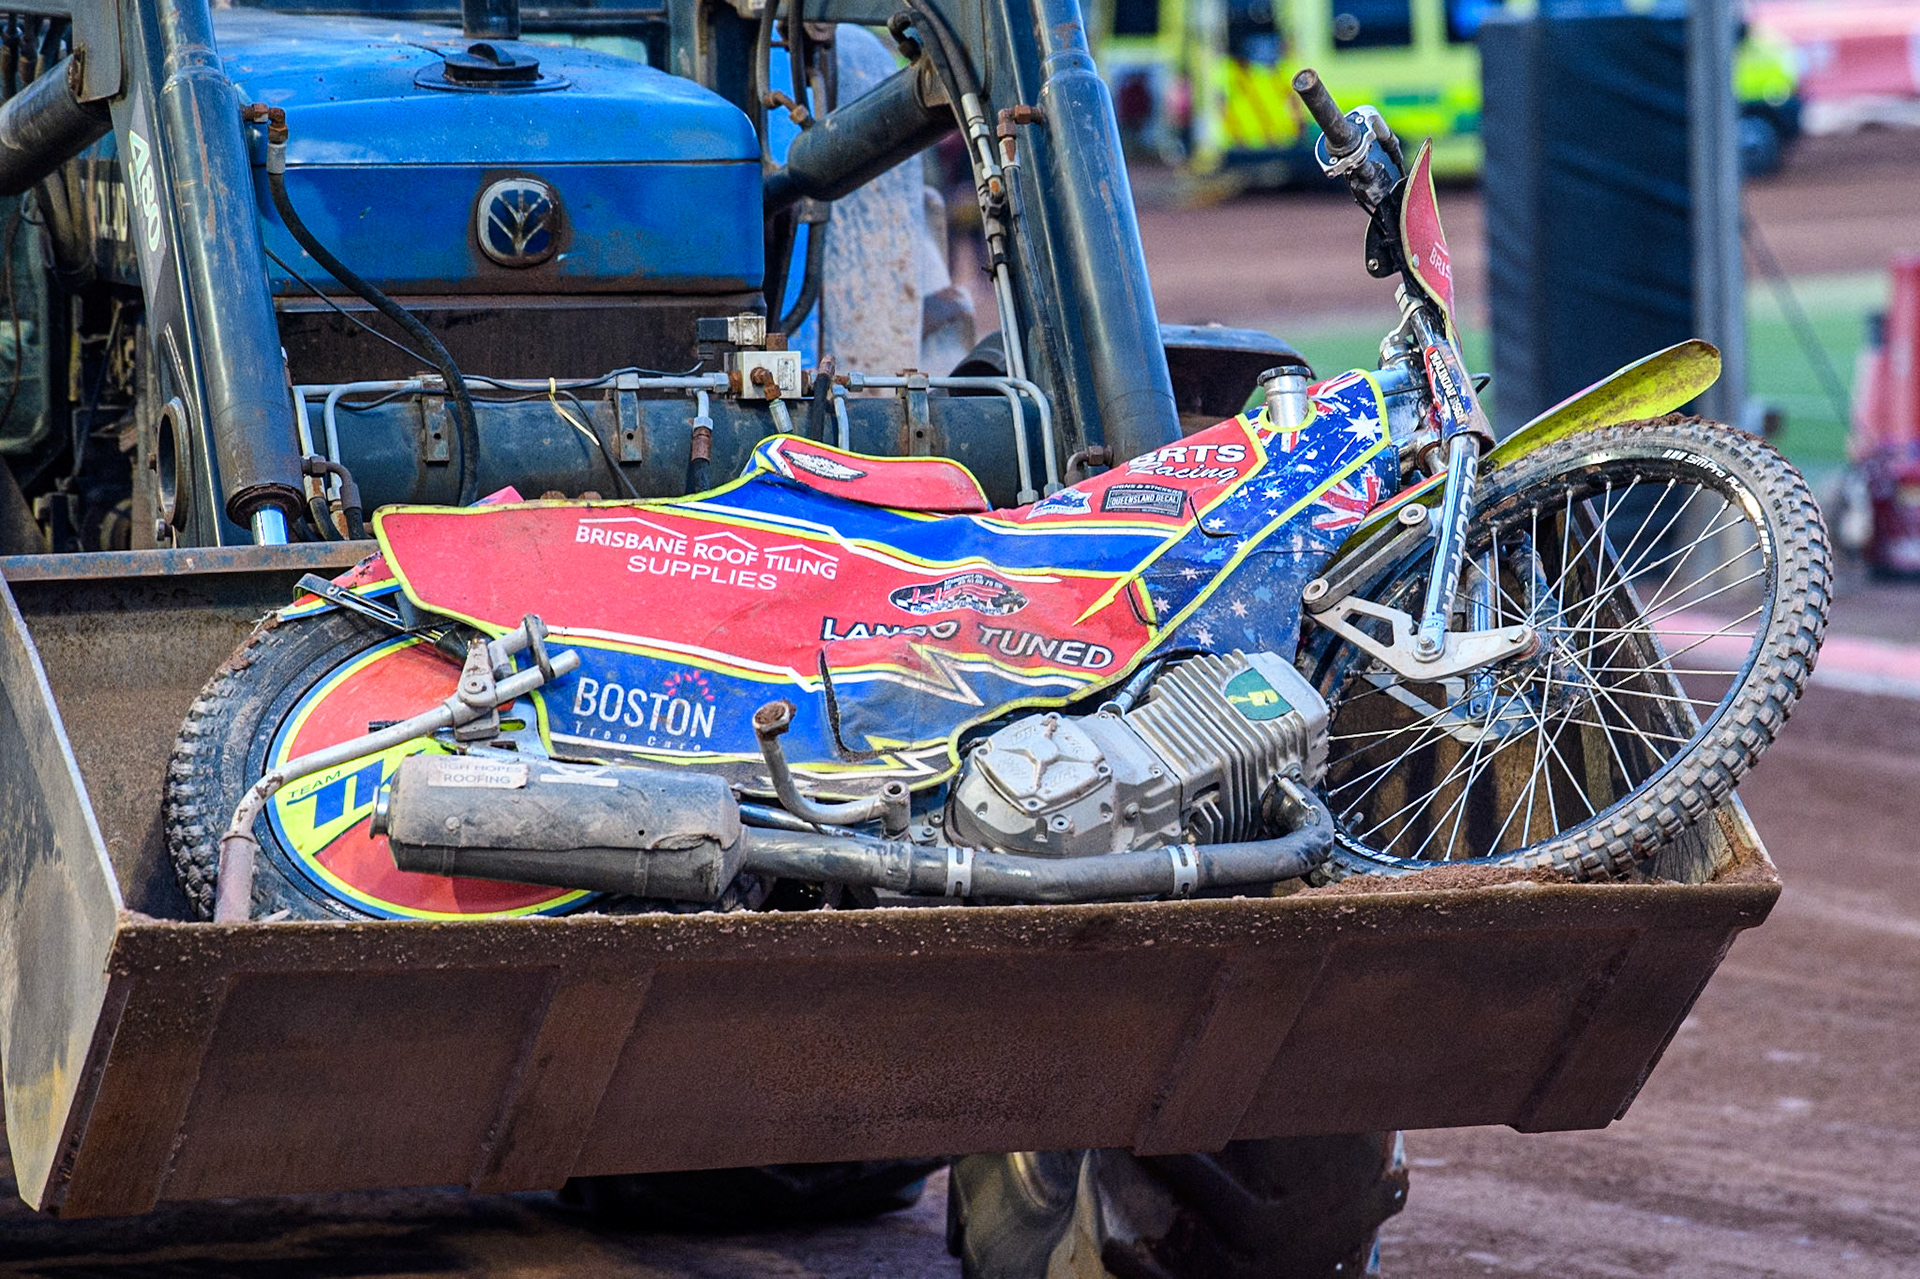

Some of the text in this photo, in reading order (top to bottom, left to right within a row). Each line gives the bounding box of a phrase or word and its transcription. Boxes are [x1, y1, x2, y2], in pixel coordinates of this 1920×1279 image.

[128, 129, 161, 252] A80
[1110, 493, 1155, 506] QUEENSLAND
[575, 525, 838, 581] BRISBANE ROOF TILING
[626, 555, 778, 590] SUPPLIES
[977, 622, 1115, 670] TUNED
[572, 676, 716, 739] BOSTON
[287, 770, 341, 799] TEAM
[443, 773, 511, 785] ROOFING
